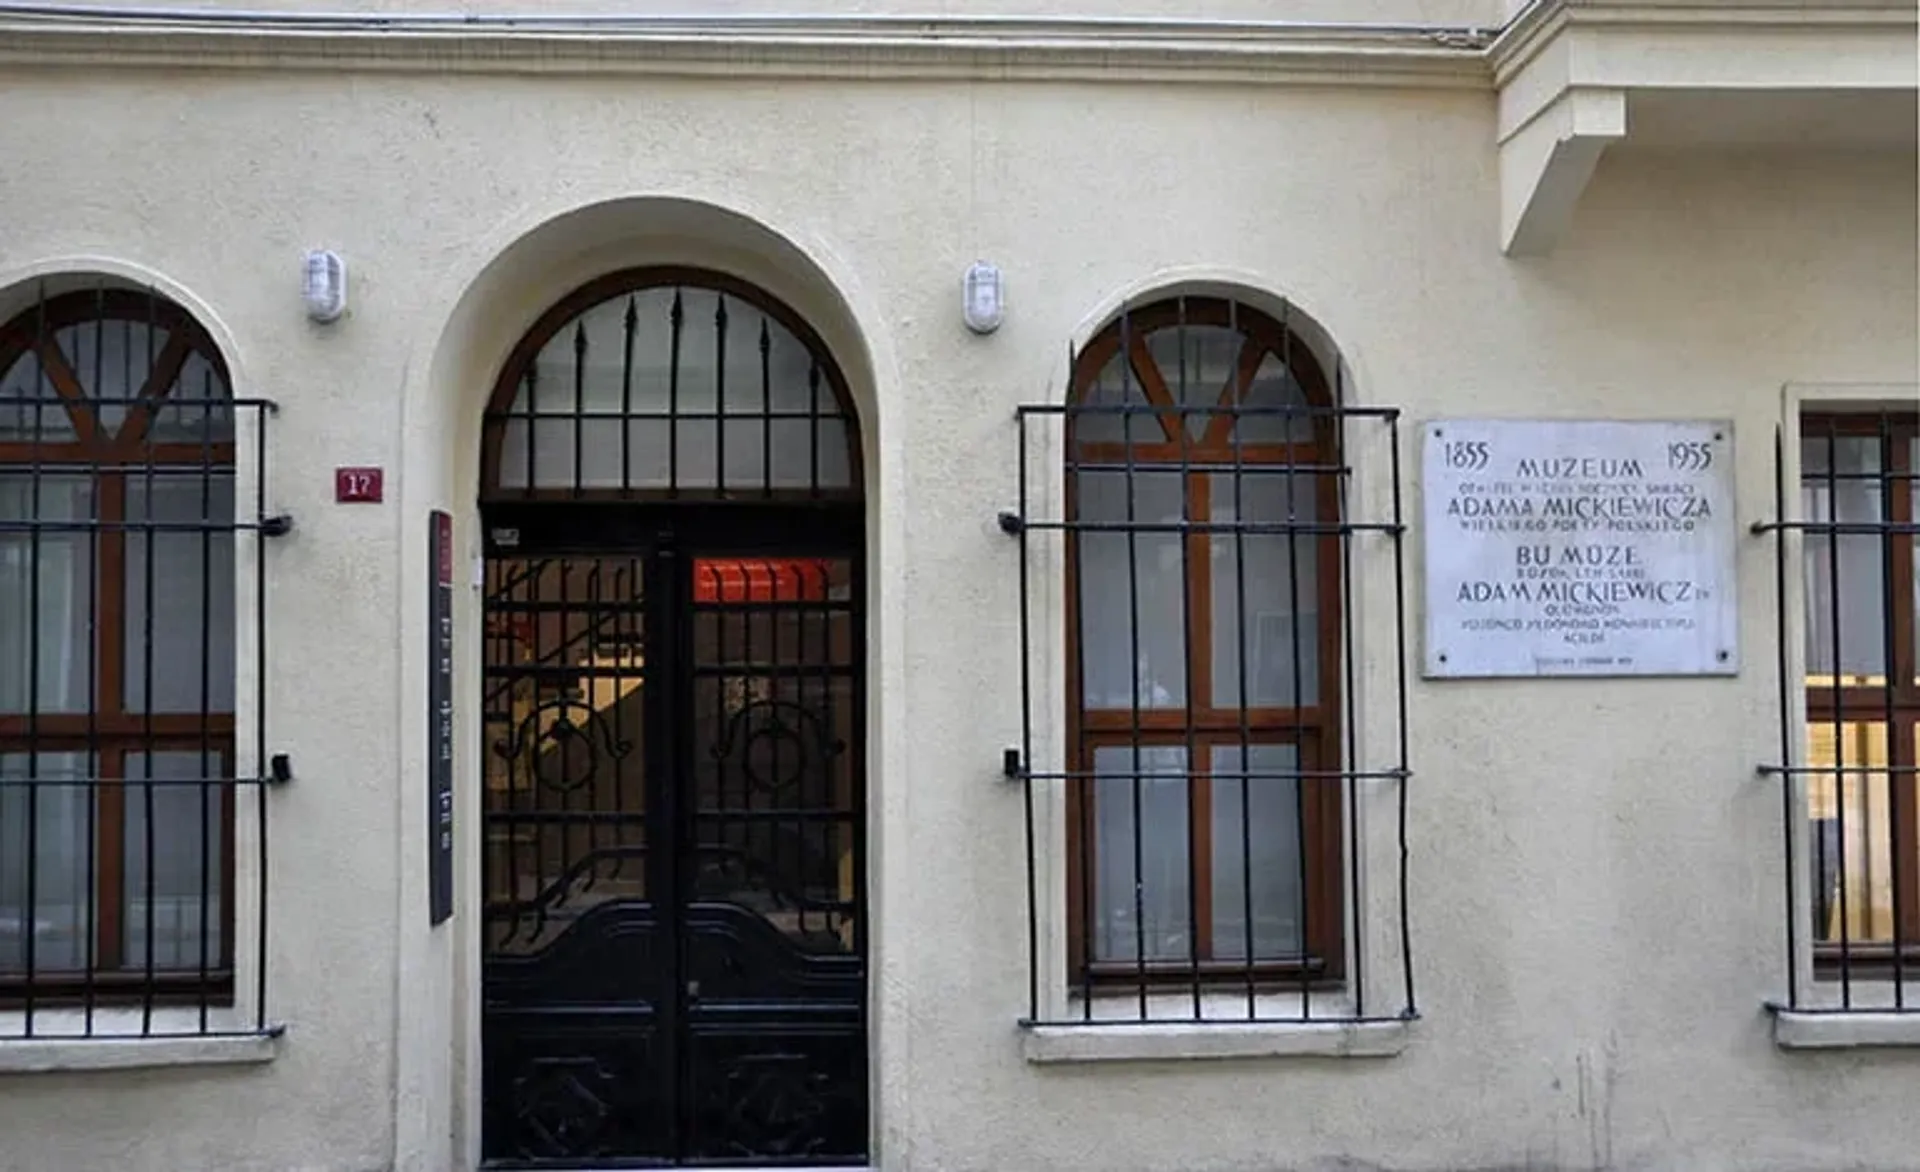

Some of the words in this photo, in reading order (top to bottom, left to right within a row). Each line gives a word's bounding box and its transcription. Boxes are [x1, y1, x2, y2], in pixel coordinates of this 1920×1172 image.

[1446, 442, 1490, 470] 1855
[1517, 458, 1644, 478] MUZEUM
[1669, 442, 1712, 470] 1955
[349, 474, 371, 495] 17
[1447, 497, 1534, 517] ADAMA
[1542, 496, 1712, 520] MICKIEWICZA
[1516, 546, 1550, 566] BU
[1456, 581, 1531, 602] ADAM
[1536, 580, 1692, 604] MICKIEWICZ
